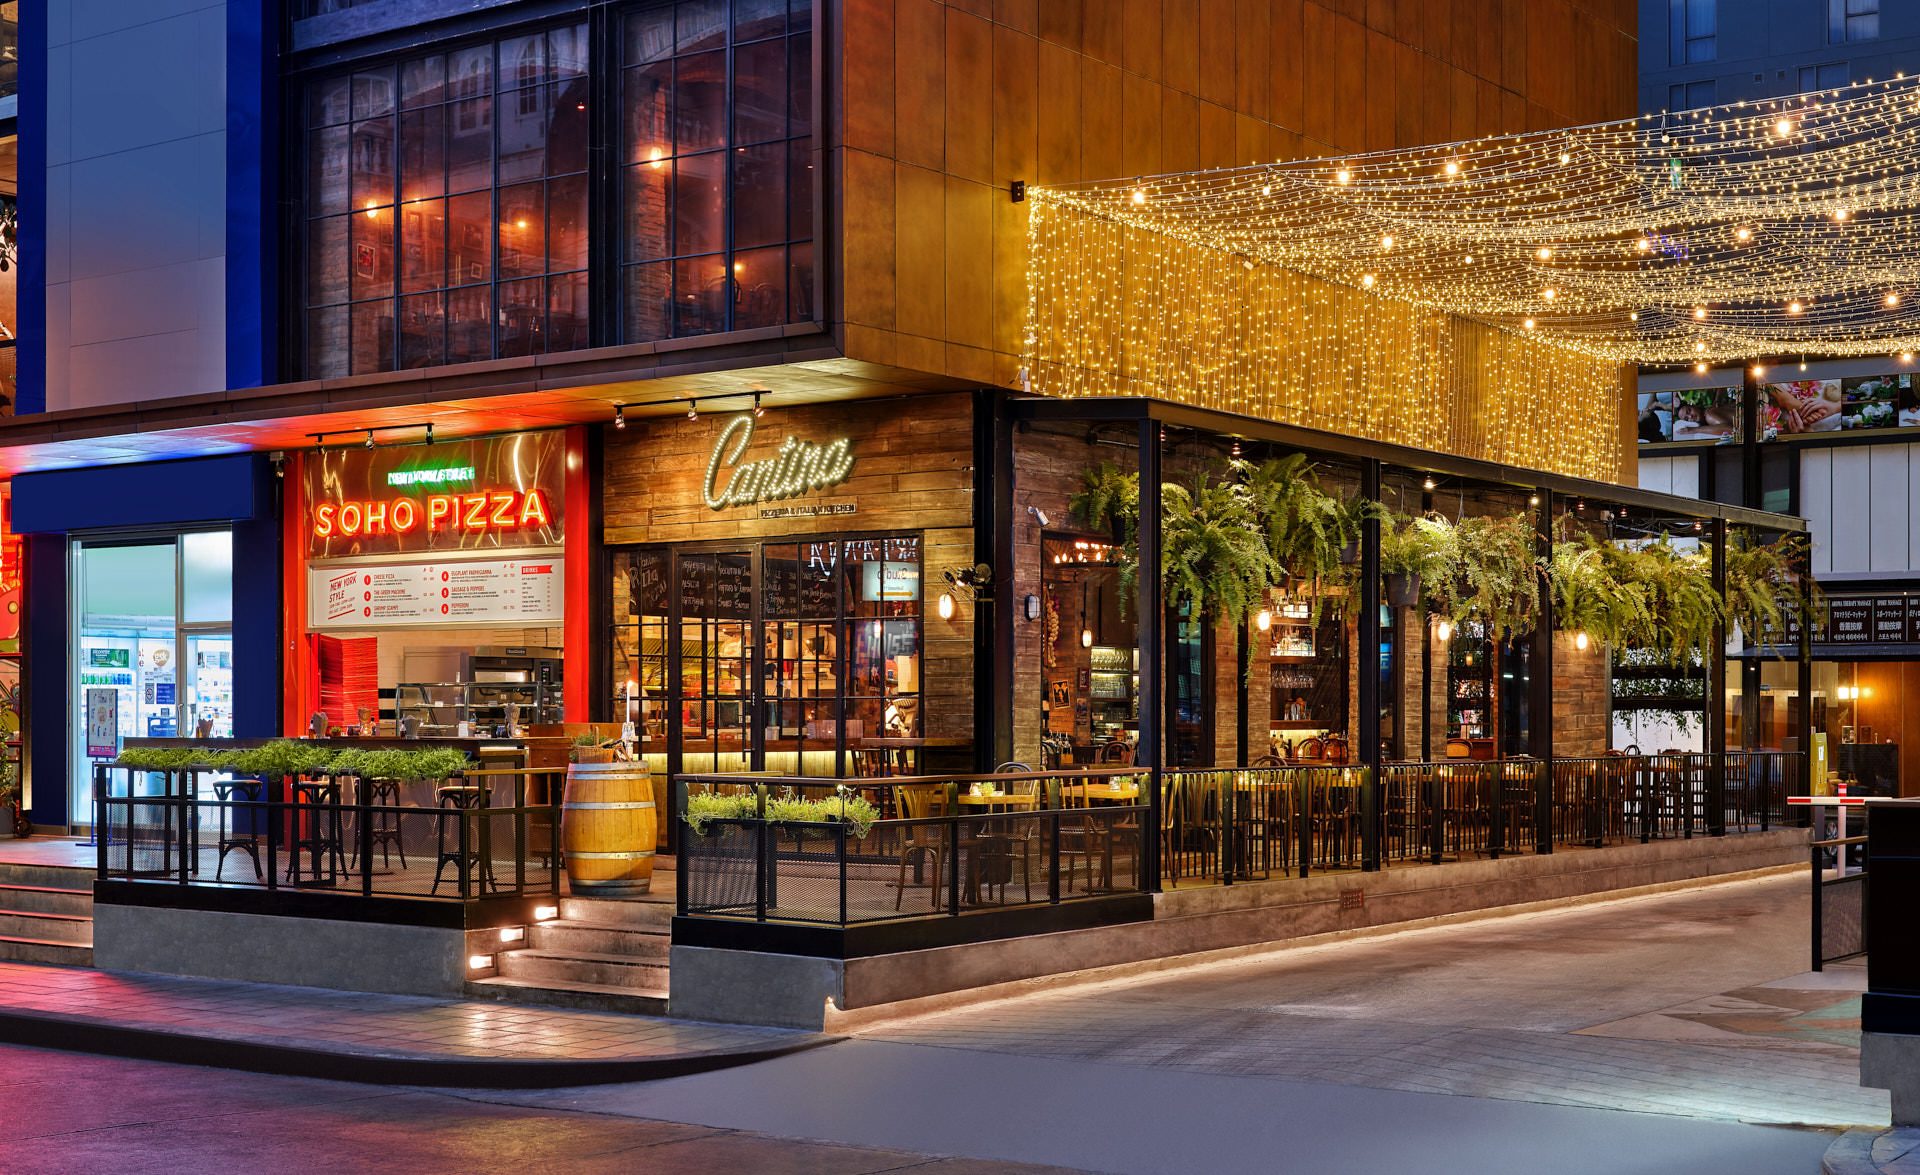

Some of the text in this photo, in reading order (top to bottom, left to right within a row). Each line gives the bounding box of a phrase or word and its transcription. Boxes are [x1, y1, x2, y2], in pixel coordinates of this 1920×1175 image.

[704, 414, 855, 510] Cantina
[315, 488, 554, 537] SOHO PIZZA
[329, 590, 345, 603] STYLE
[330, 575, 357, 591] NEW YORK
